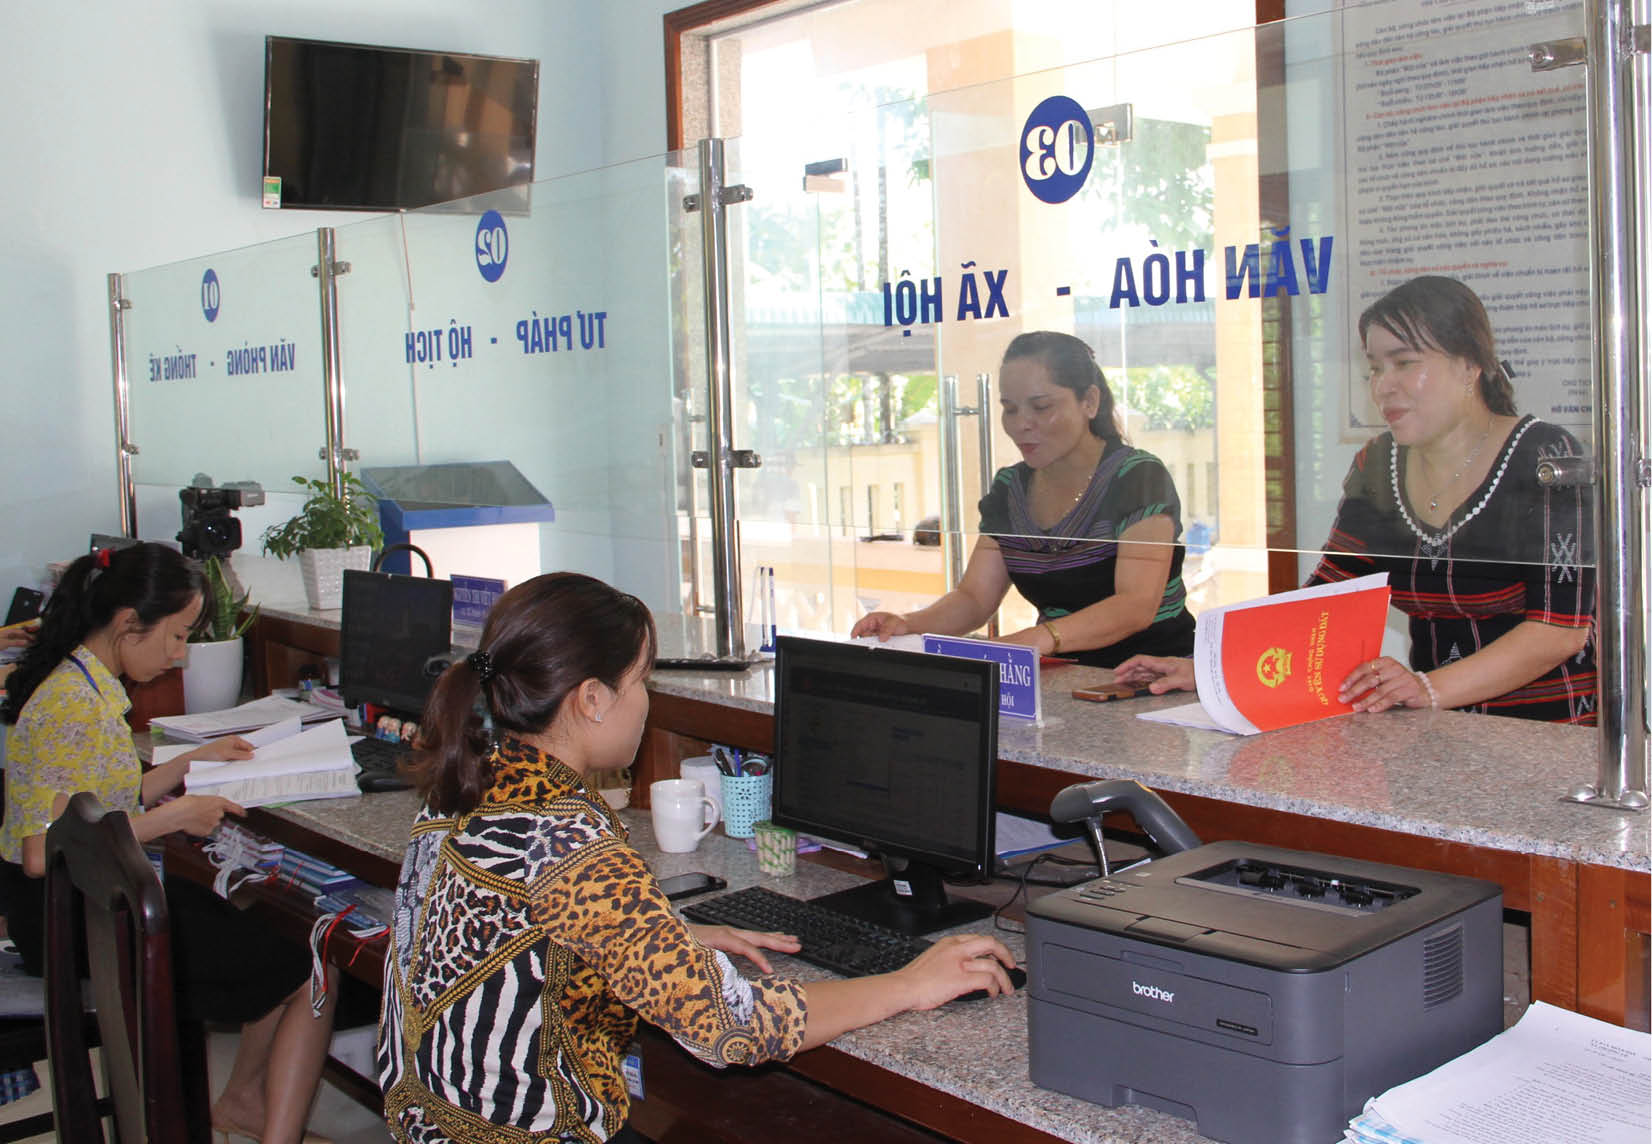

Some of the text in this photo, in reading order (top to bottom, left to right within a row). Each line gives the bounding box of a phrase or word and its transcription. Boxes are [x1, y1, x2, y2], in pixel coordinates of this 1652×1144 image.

[999, 652, 1031, 687] HẰNG
[1001, 692, 1015, 709] HỘI
[1132, 980, 1175, 1004] brother
